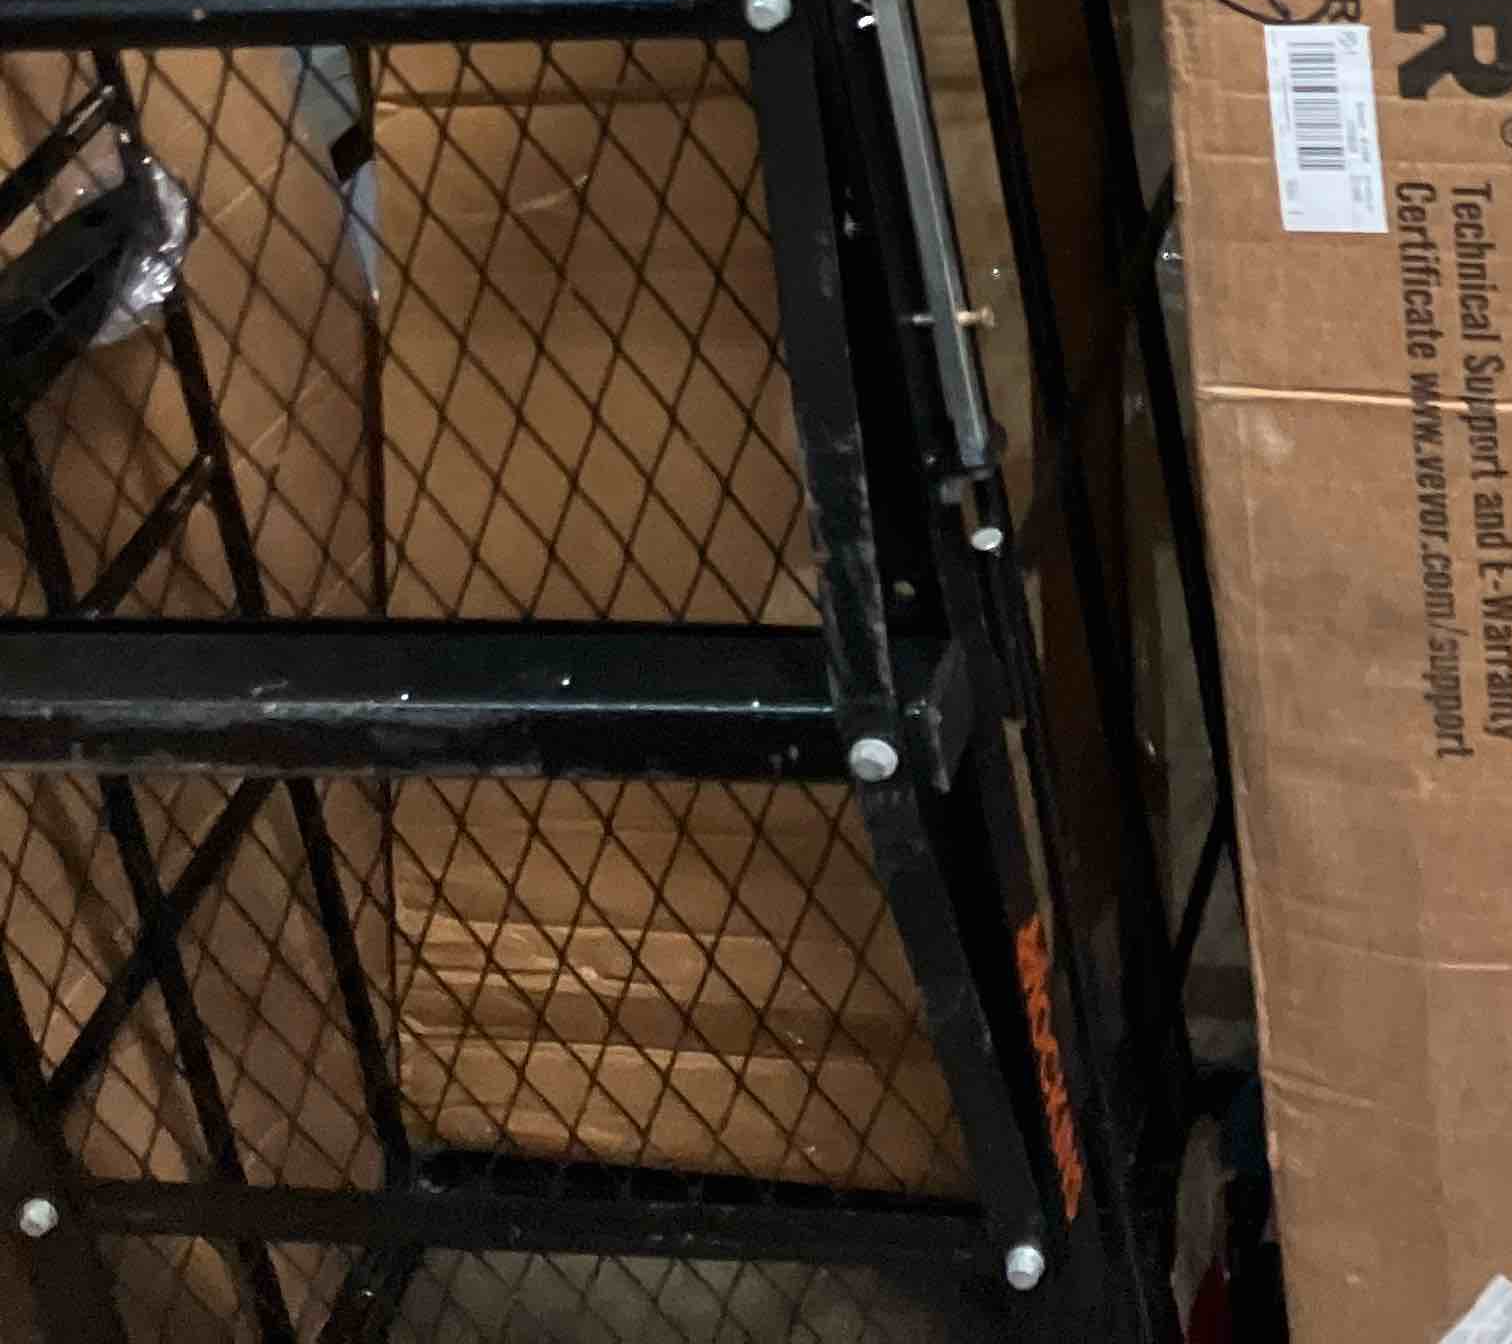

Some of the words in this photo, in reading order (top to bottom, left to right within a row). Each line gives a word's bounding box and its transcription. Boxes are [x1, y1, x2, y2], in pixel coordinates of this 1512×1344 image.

[1395, 181, 1444, 360] Certificate
[1451, 179, 1502, 343] Technical
[1455, 353, 1509, 481] Support
[1409, 371, 1475, 760] www.vevor.com/support
